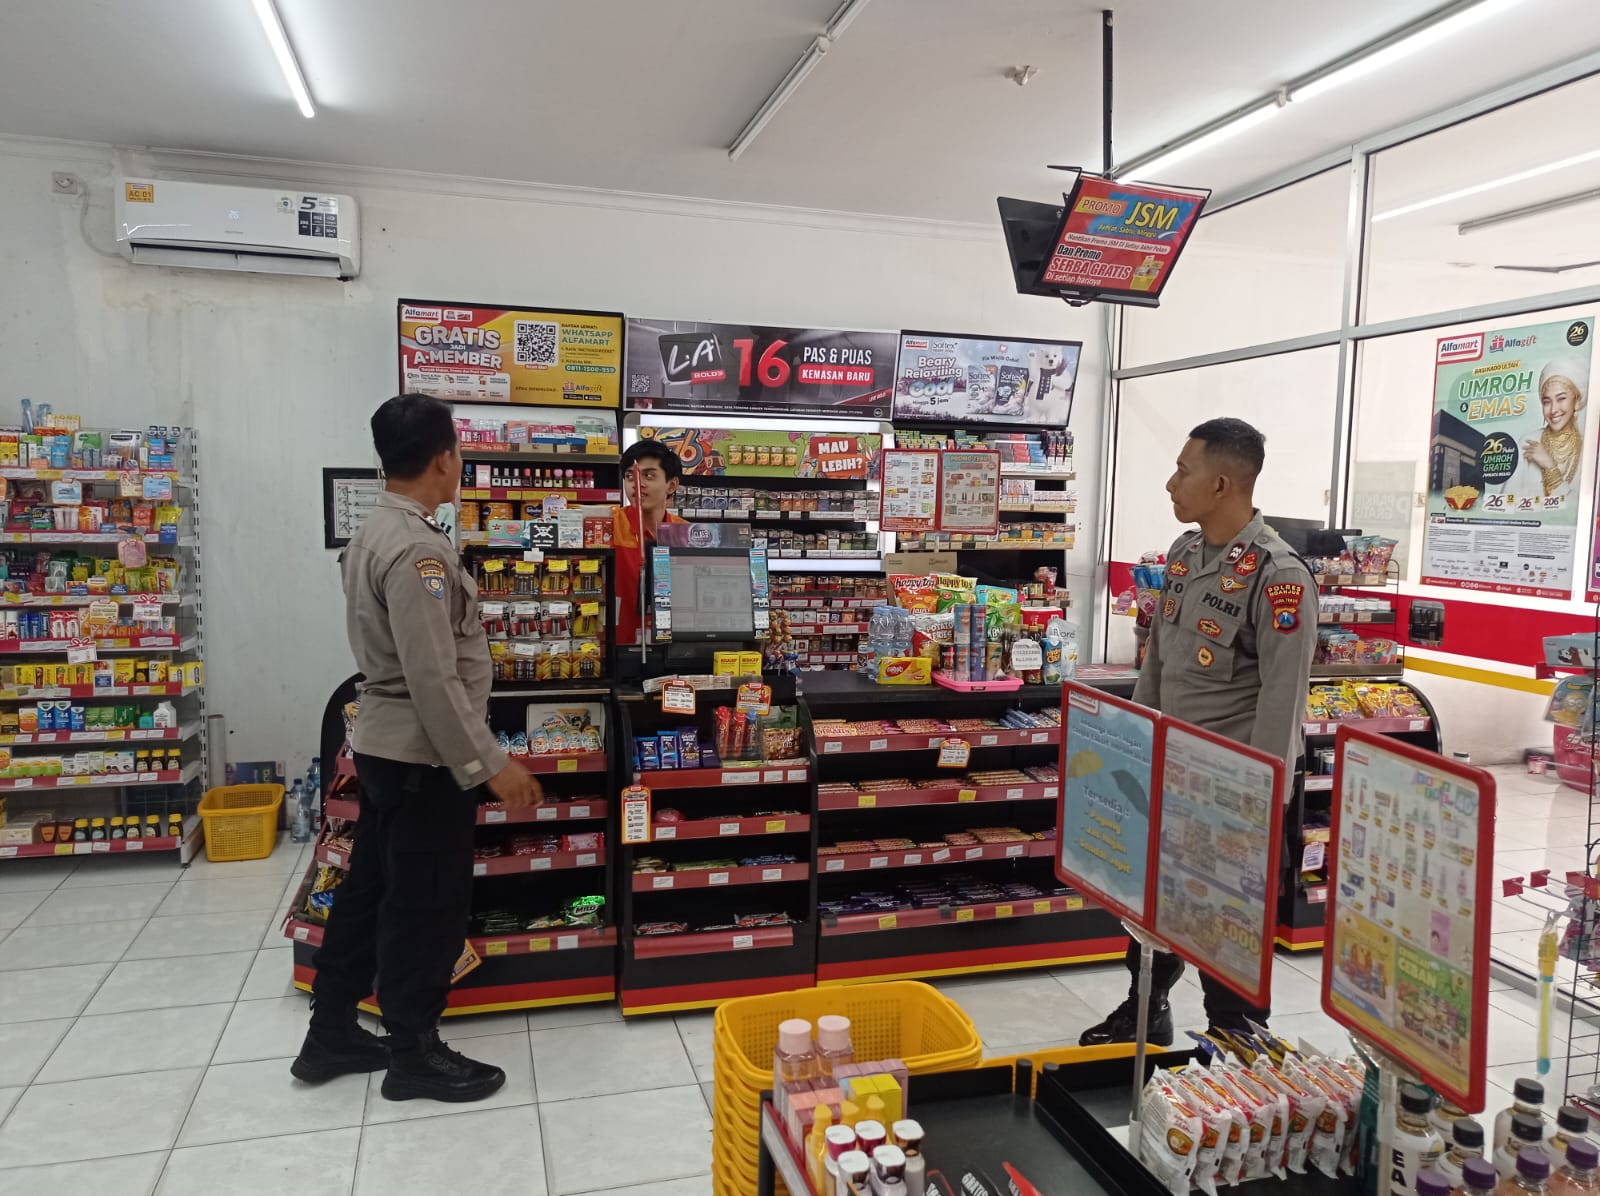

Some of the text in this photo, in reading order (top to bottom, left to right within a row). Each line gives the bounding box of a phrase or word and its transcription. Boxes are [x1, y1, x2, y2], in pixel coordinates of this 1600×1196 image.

[300, 196, 318, 210] 5
[1081, 199, 1121, 214] PROMO
[1124, 201, 1179, 230] JSM
[1056, 245, 1102, 260] Dan Promo
[1051, 258, 1132, 279] SERBA GRATIS
[405, 309, 439, 318] Alfamart
[415, 326, 501, 350] GRATIS
[562, 329, 613, 338] WHATSAPP
[1569, 326, 1585, 338] 26
[562, 337, 610, 346] ALFAMART
[1441, 340, 1478, 352] Alfamart
[1504, 335, 1537, 349] Alfagift
[734, 338, 790, 388] 16
[803, 346, 872, 366] PAS & PUAS
[919, 357, 956, 370] Beary
[694, 371, 718, 379] BOLD
[802, 368, 871, 382] KEMASAN BARU
[1460, 371, 1533, 399] UMROH
[931, 397, 938, 405] 5
[1461, 395, 1527, 420] & EMAS
[818, 440, 849, 457] MAU
[1481, 437, 1506, 458] 26
[1484, 453, 1513, 463] UMROH
[821, 457, 863, 476] LEBIH?
[1483, 462, 1511, 472] GRATIS
[1486, 494, 1505, 508] 26
[1519, 498, 1534, 509] 26
[1544, 496, 1560, 506] 206
[937, 576, 960, 590] Happy
[1268, 584, 1301, 593] POLRES
[1202, 592, 1241, 617] POLRI
[926, 622, 955, 633] POTATO
